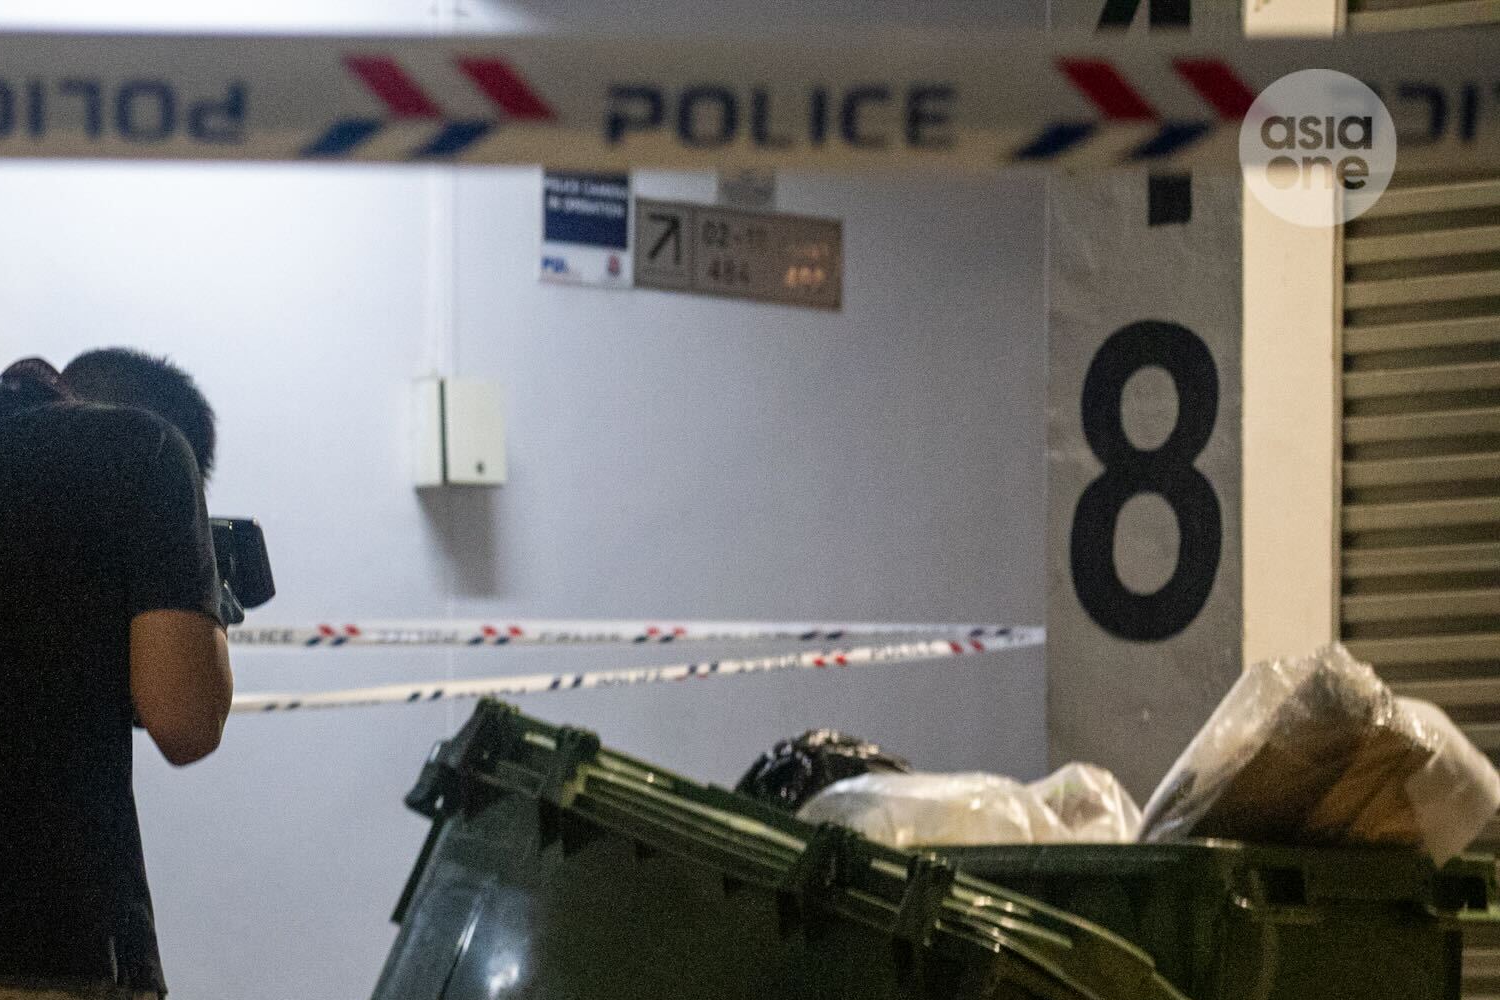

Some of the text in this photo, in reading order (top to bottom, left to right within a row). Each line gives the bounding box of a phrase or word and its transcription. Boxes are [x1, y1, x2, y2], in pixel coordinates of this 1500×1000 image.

[604, 80, 958, 148] POLICE
[1070, 319, 1223, 643] 8
[228, 628, 295, 645] OLICE
